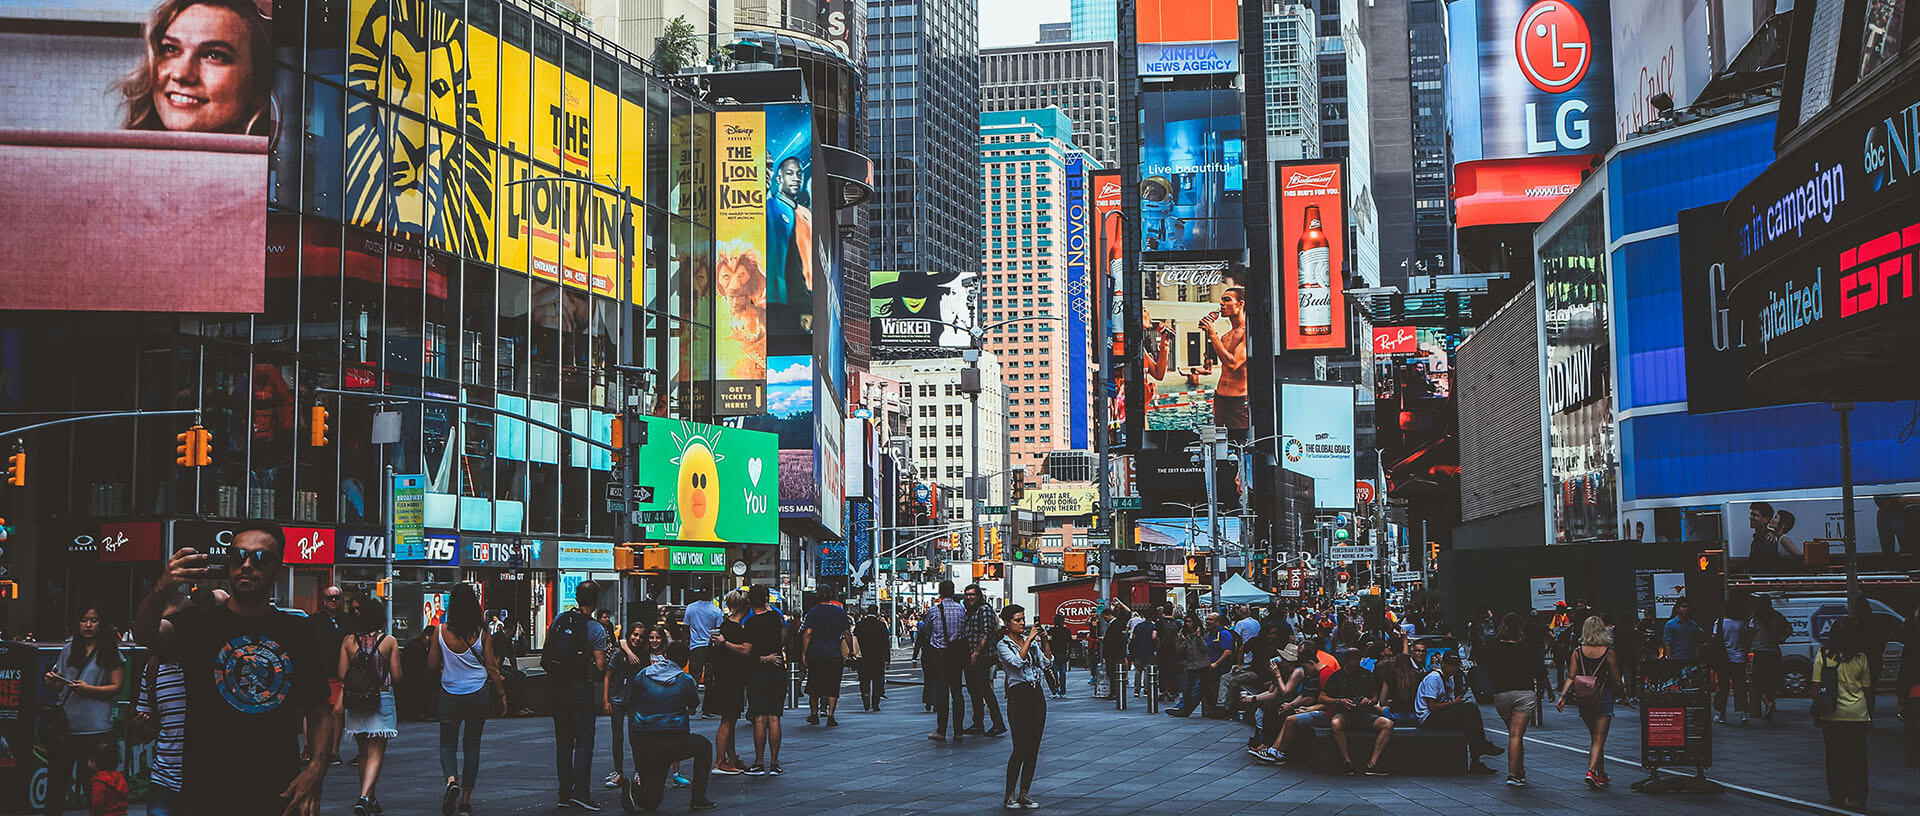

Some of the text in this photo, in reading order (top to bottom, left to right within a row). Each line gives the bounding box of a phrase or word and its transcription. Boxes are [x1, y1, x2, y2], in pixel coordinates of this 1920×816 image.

[1160, 47, 1218, 61] XINHUA
[1146, 60, 1232, 72] NEWS AGENCY
[549, 104, 589, 158] THE
[723, 124, 754, 136] Disney
[1525, 99, 1592, 154] LG
[726, 146, 752, 158] THE
[721, 162, 758, 183] LION
[1148, 162, 1231, 174] Live beautiful
[508, 141, 636, 260] LION KIN
[720, 184, 763, 209] KING
[1767, 162, 1846, 238] campaign
[1068, 165, 1084, 267] NOVOTEL
[533, 259, 559, 275] ENTRANCE
[564, 269, 573, 279] ON
[880, 318, 931, 335] WICKED
[1375, 328, 1414, 350] Ray-Ban
[1546, 343, 1592, 415] OLD NAVY
[1305, 444, 1351, 454] THE GLOBAL GOALS
[743, 487, 768, 515] YOU
[1057, 498, 1078, 506] DOING
[1112, 498, 1119, 508] W
[1121, 498, 1132, 508] 44
[643, 511, 652, 522] W
[654, 511, 665, 522] 44
[102, 531, 129, 552] Ray-Ban
[297, 531, 325, 560] Ray-Ban
[672, 551, 723, 566] NEW YORK LINE
